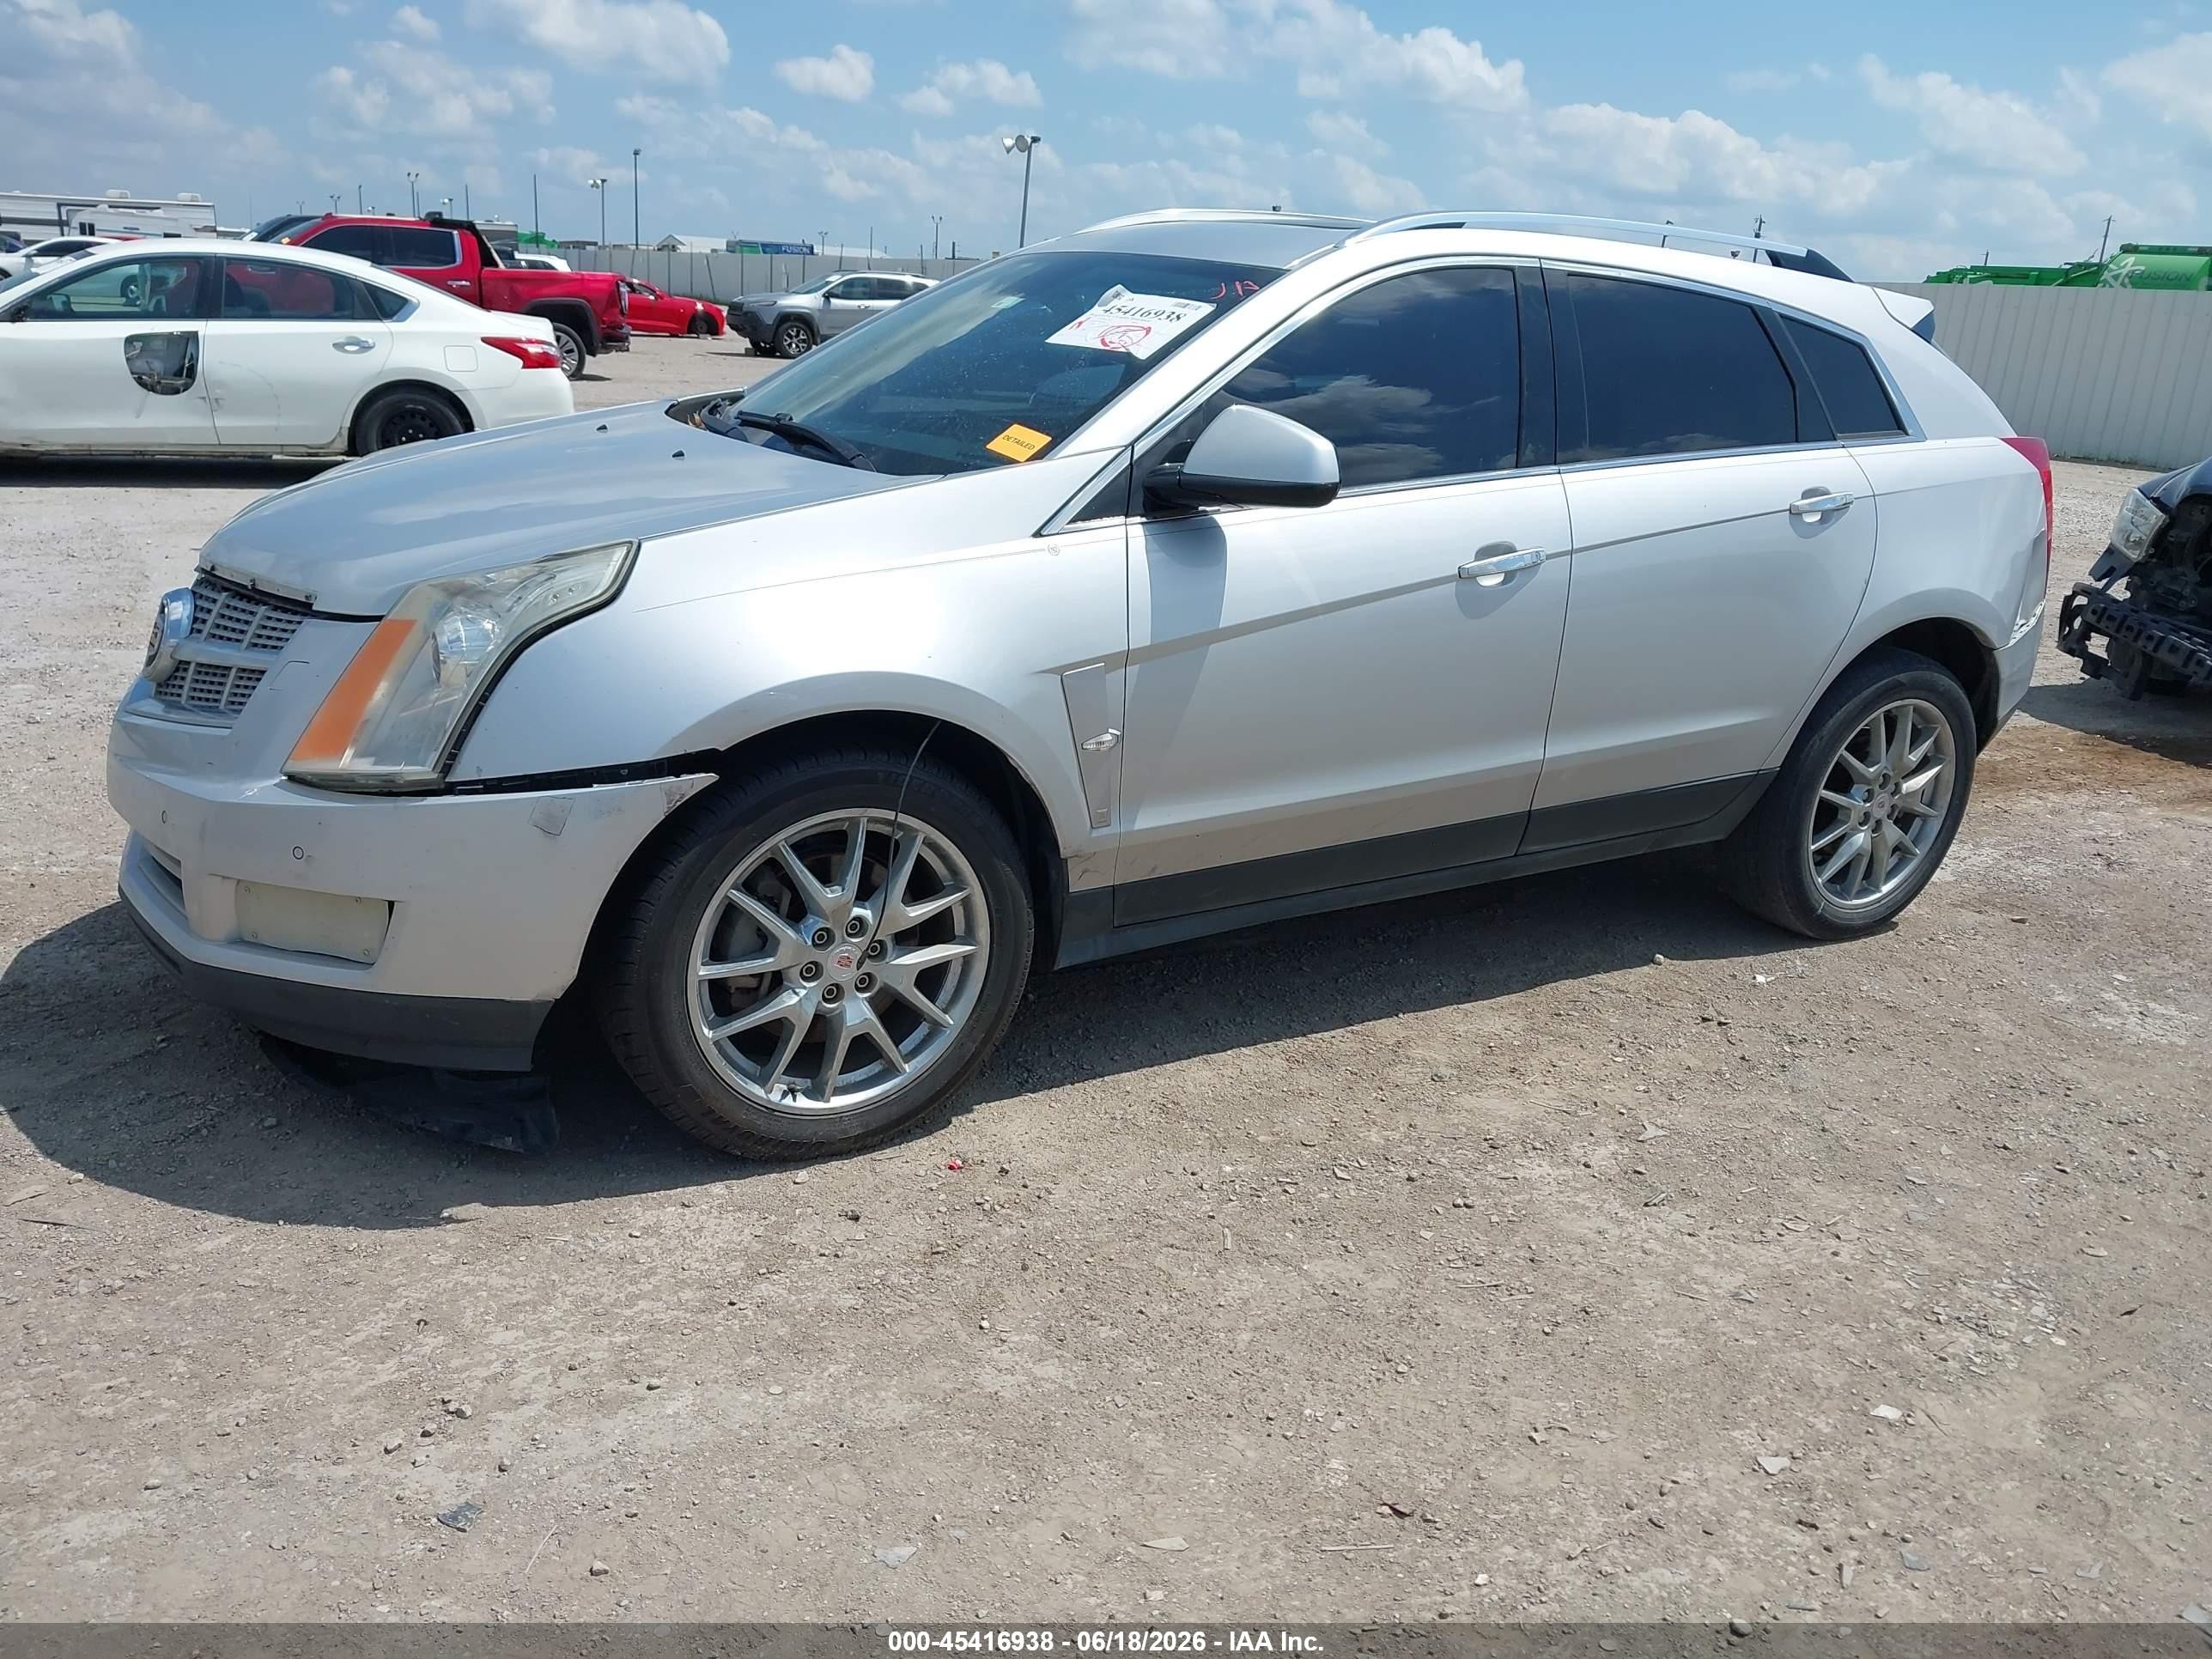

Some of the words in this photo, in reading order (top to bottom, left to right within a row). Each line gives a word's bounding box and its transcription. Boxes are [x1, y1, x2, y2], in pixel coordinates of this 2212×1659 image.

[781, 246, 811, 254] FUSION
[1102, 304, 1187, 324] 45416938
[1002, 434, 1036, 451] DETAILED
